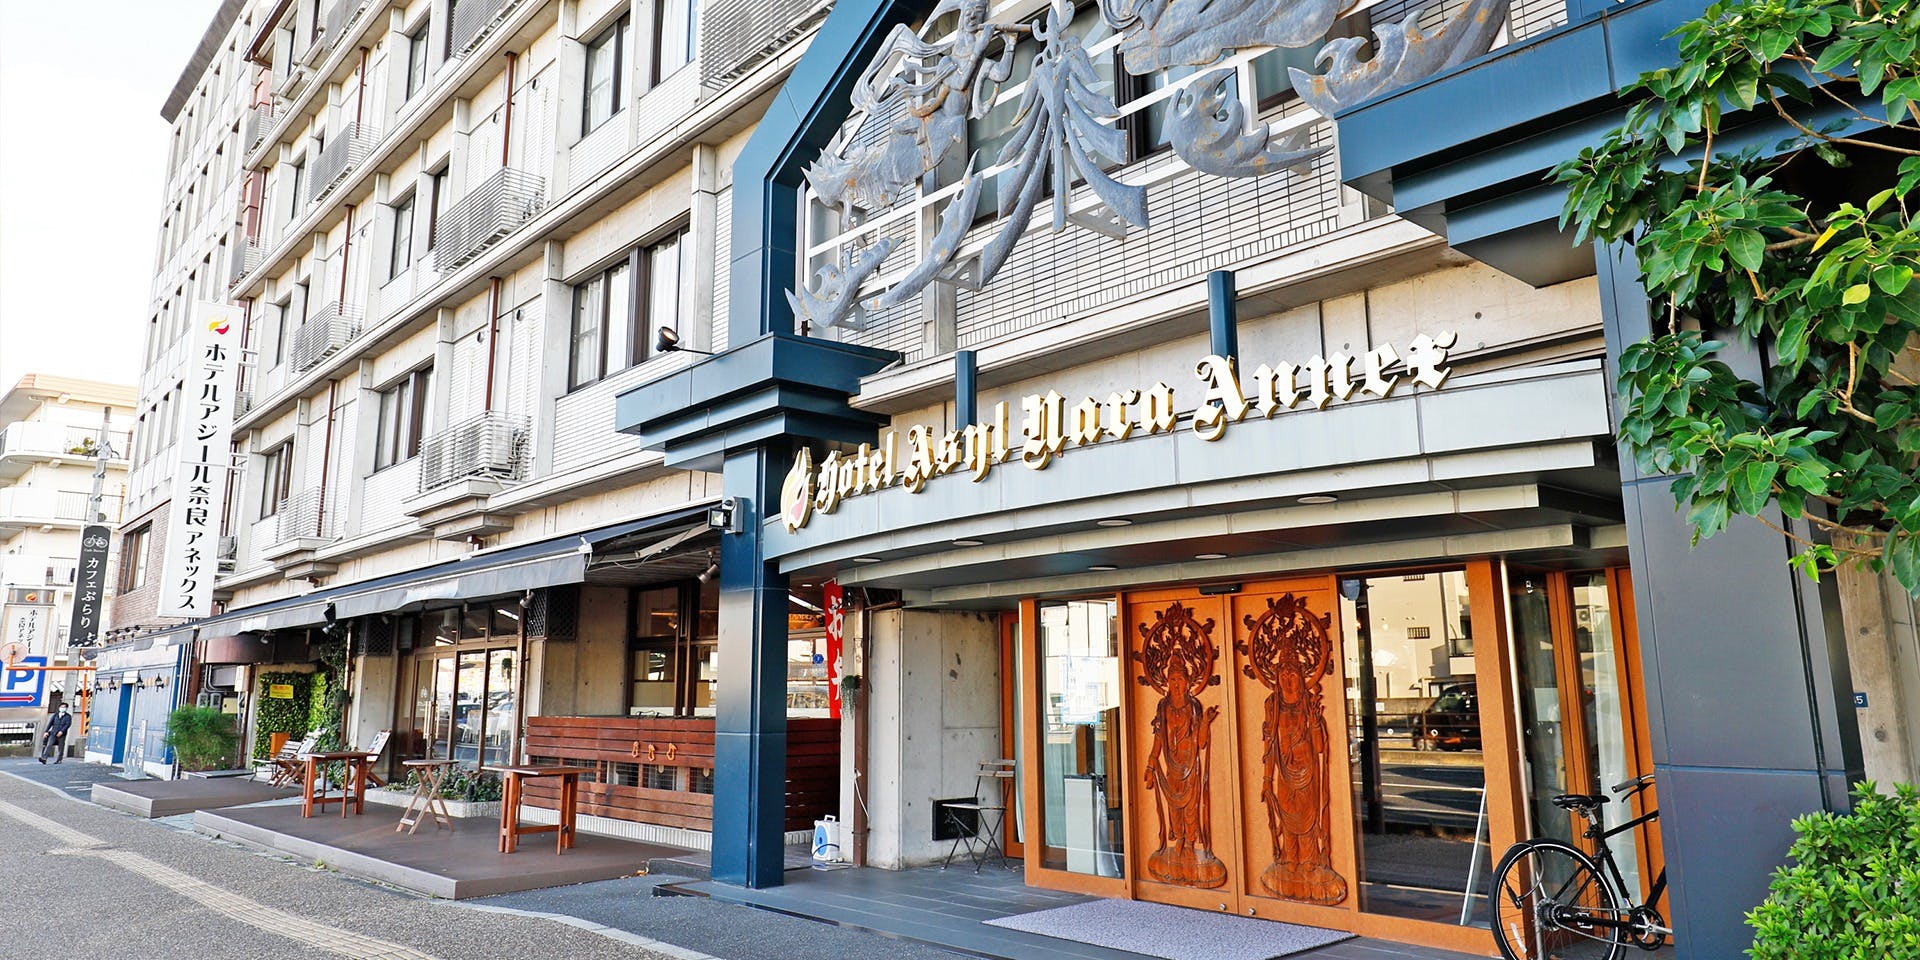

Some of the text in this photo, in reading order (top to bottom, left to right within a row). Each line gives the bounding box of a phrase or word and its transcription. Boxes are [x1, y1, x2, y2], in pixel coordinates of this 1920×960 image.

[815, 329, 1458, 515] Hotel Asyl Nara Annex
[178, 343, 227, 610] ホテルアジール奈良アネックス
[6, 667, 35, 690] P
[1854, 695, 1864, 705] 5
